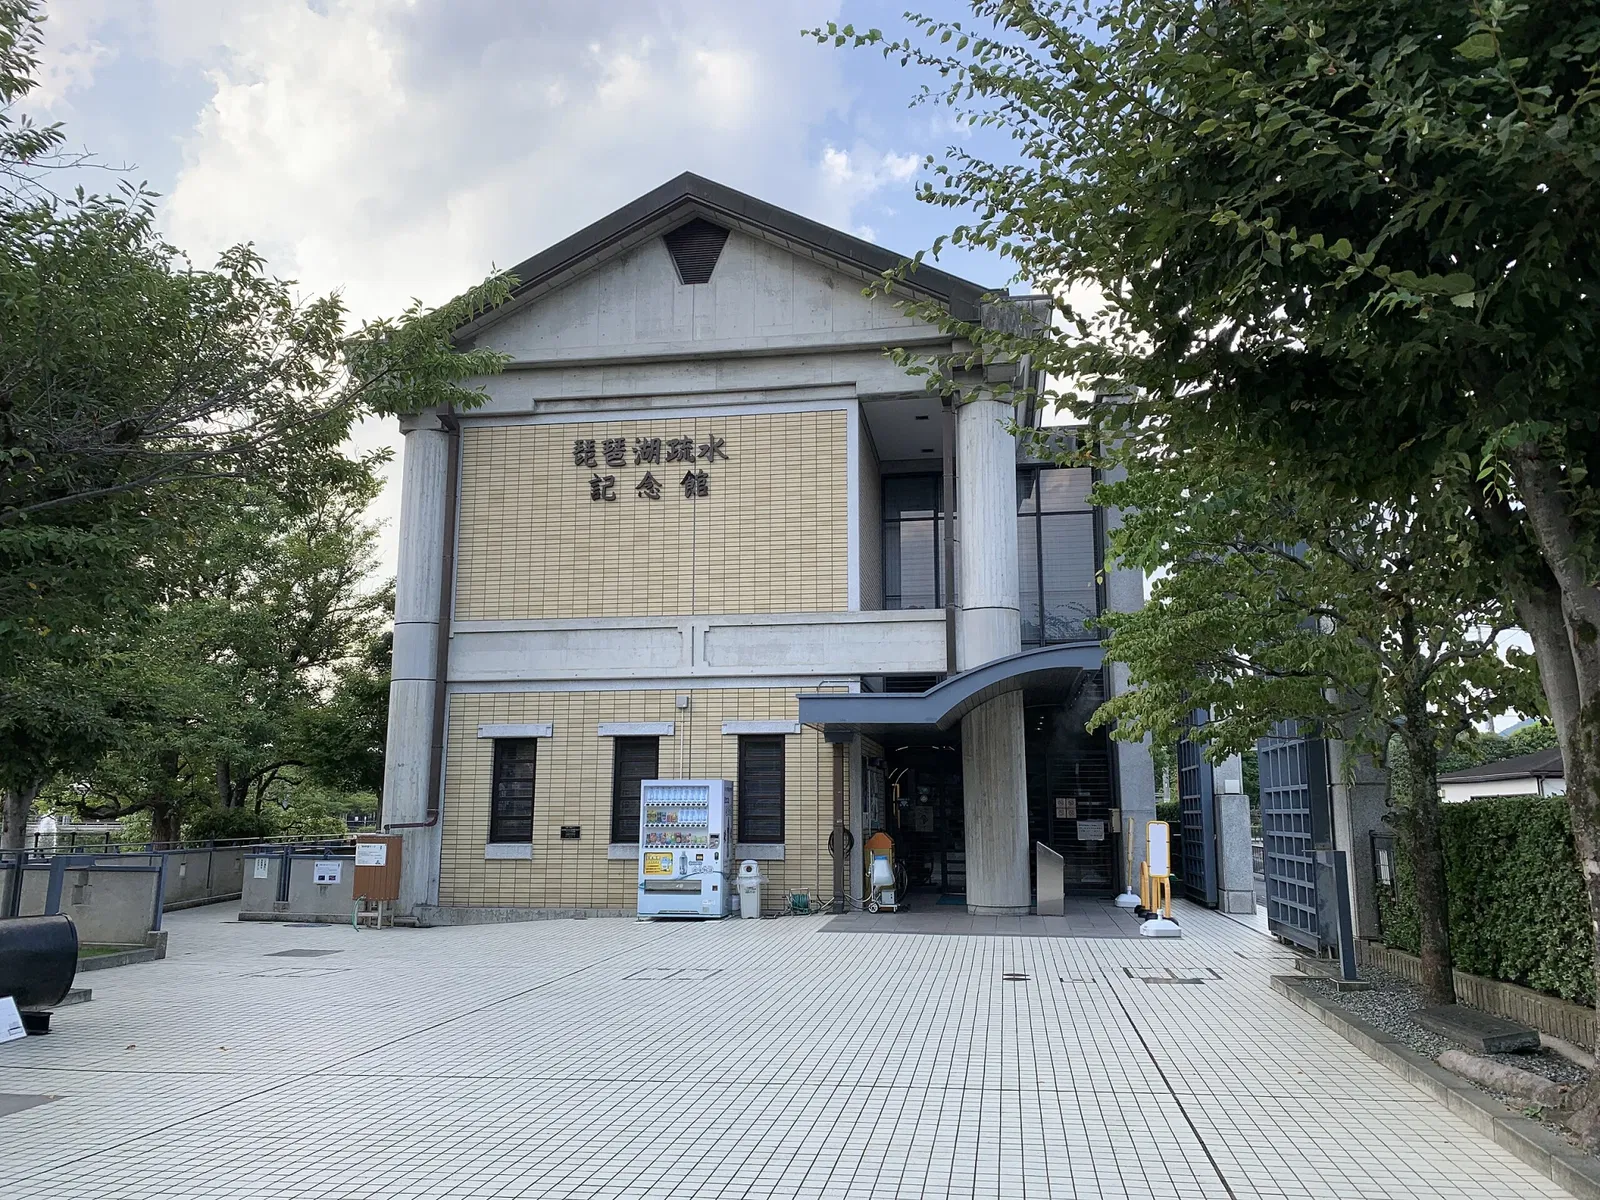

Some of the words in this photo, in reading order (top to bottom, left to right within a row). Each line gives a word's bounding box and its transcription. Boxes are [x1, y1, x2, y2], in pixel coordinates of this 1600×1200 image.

[573, 434, 729, 467] 琵琶湖疏水
[588, 469, 709, 501] 記念館
